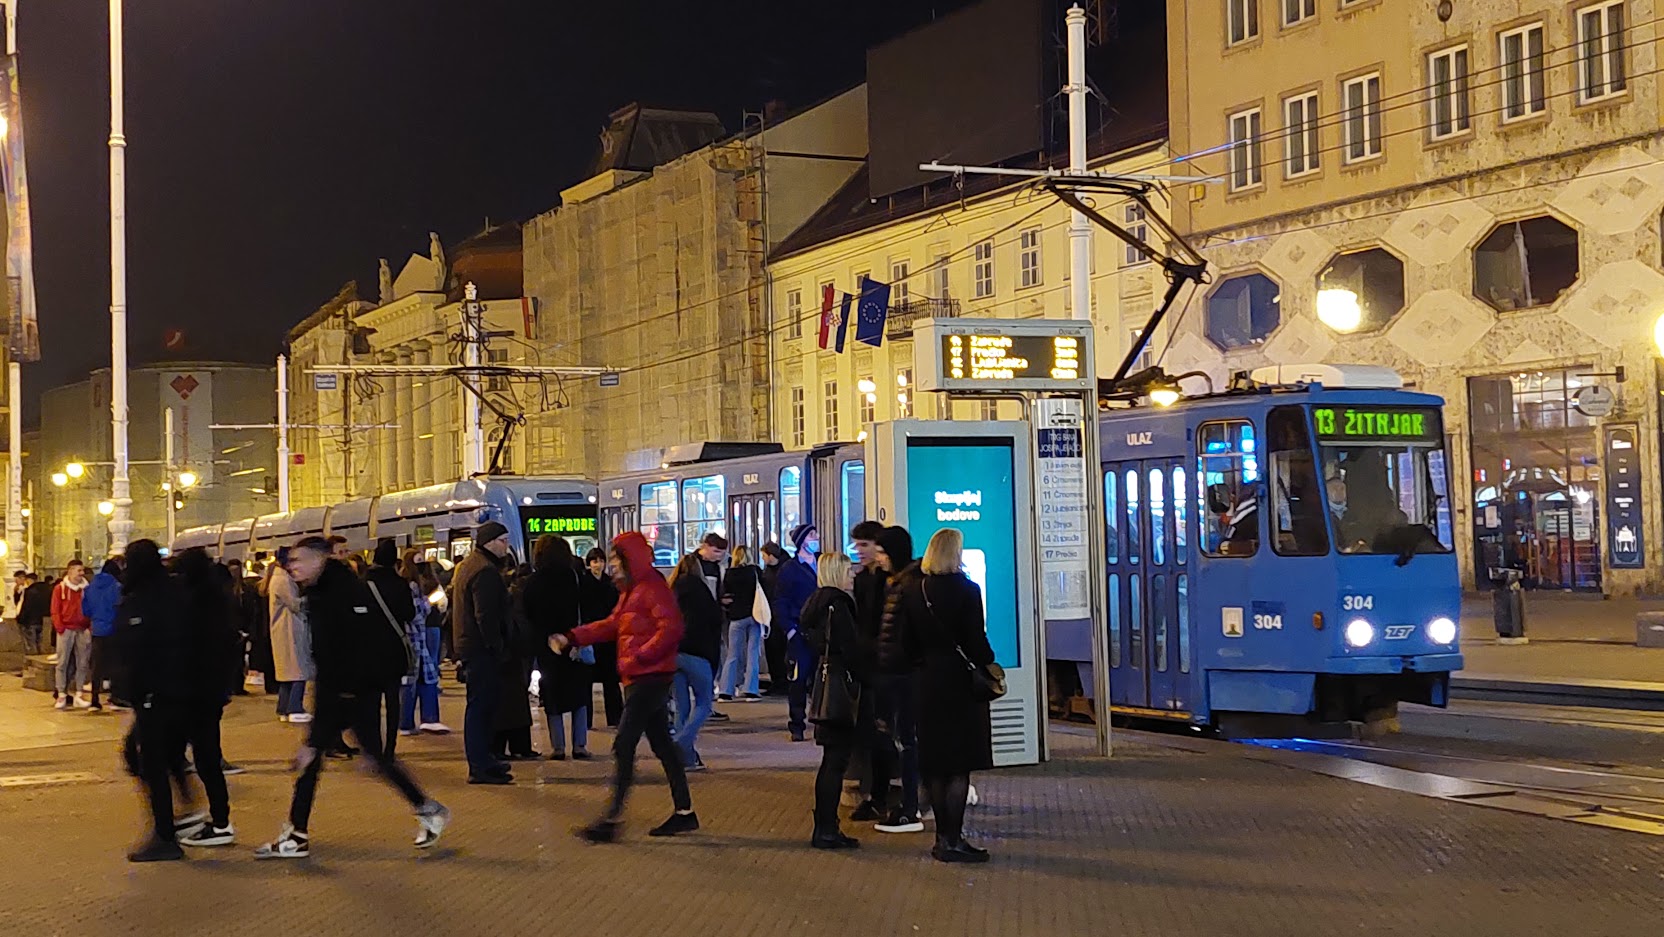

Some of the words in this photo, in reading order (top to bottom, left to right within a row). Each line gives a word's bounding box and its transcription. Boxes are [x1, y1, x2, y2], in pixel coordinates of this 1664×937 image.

[1314, 408, 1335, 435] 13
[1344, 408, 1424, 435] ŽITNJAK
[1126, 431, 1154, 446] ULAZ
[1043, 475, 1050, 484] 6
[1043, 490, 1051, 499] 11
[1041, 504, 1051, 513] 12
[937, 508, 981, 522] bodove
[527, 517, 541, 532] 14
[1042, 520, 1051, 529] 13
[1042, 533, 1051, 542] 14
[1045, 550, 1054, 558] 17
[1343, 595, 1373, 611] 304
[1253, 614, 1283, 630] 304
